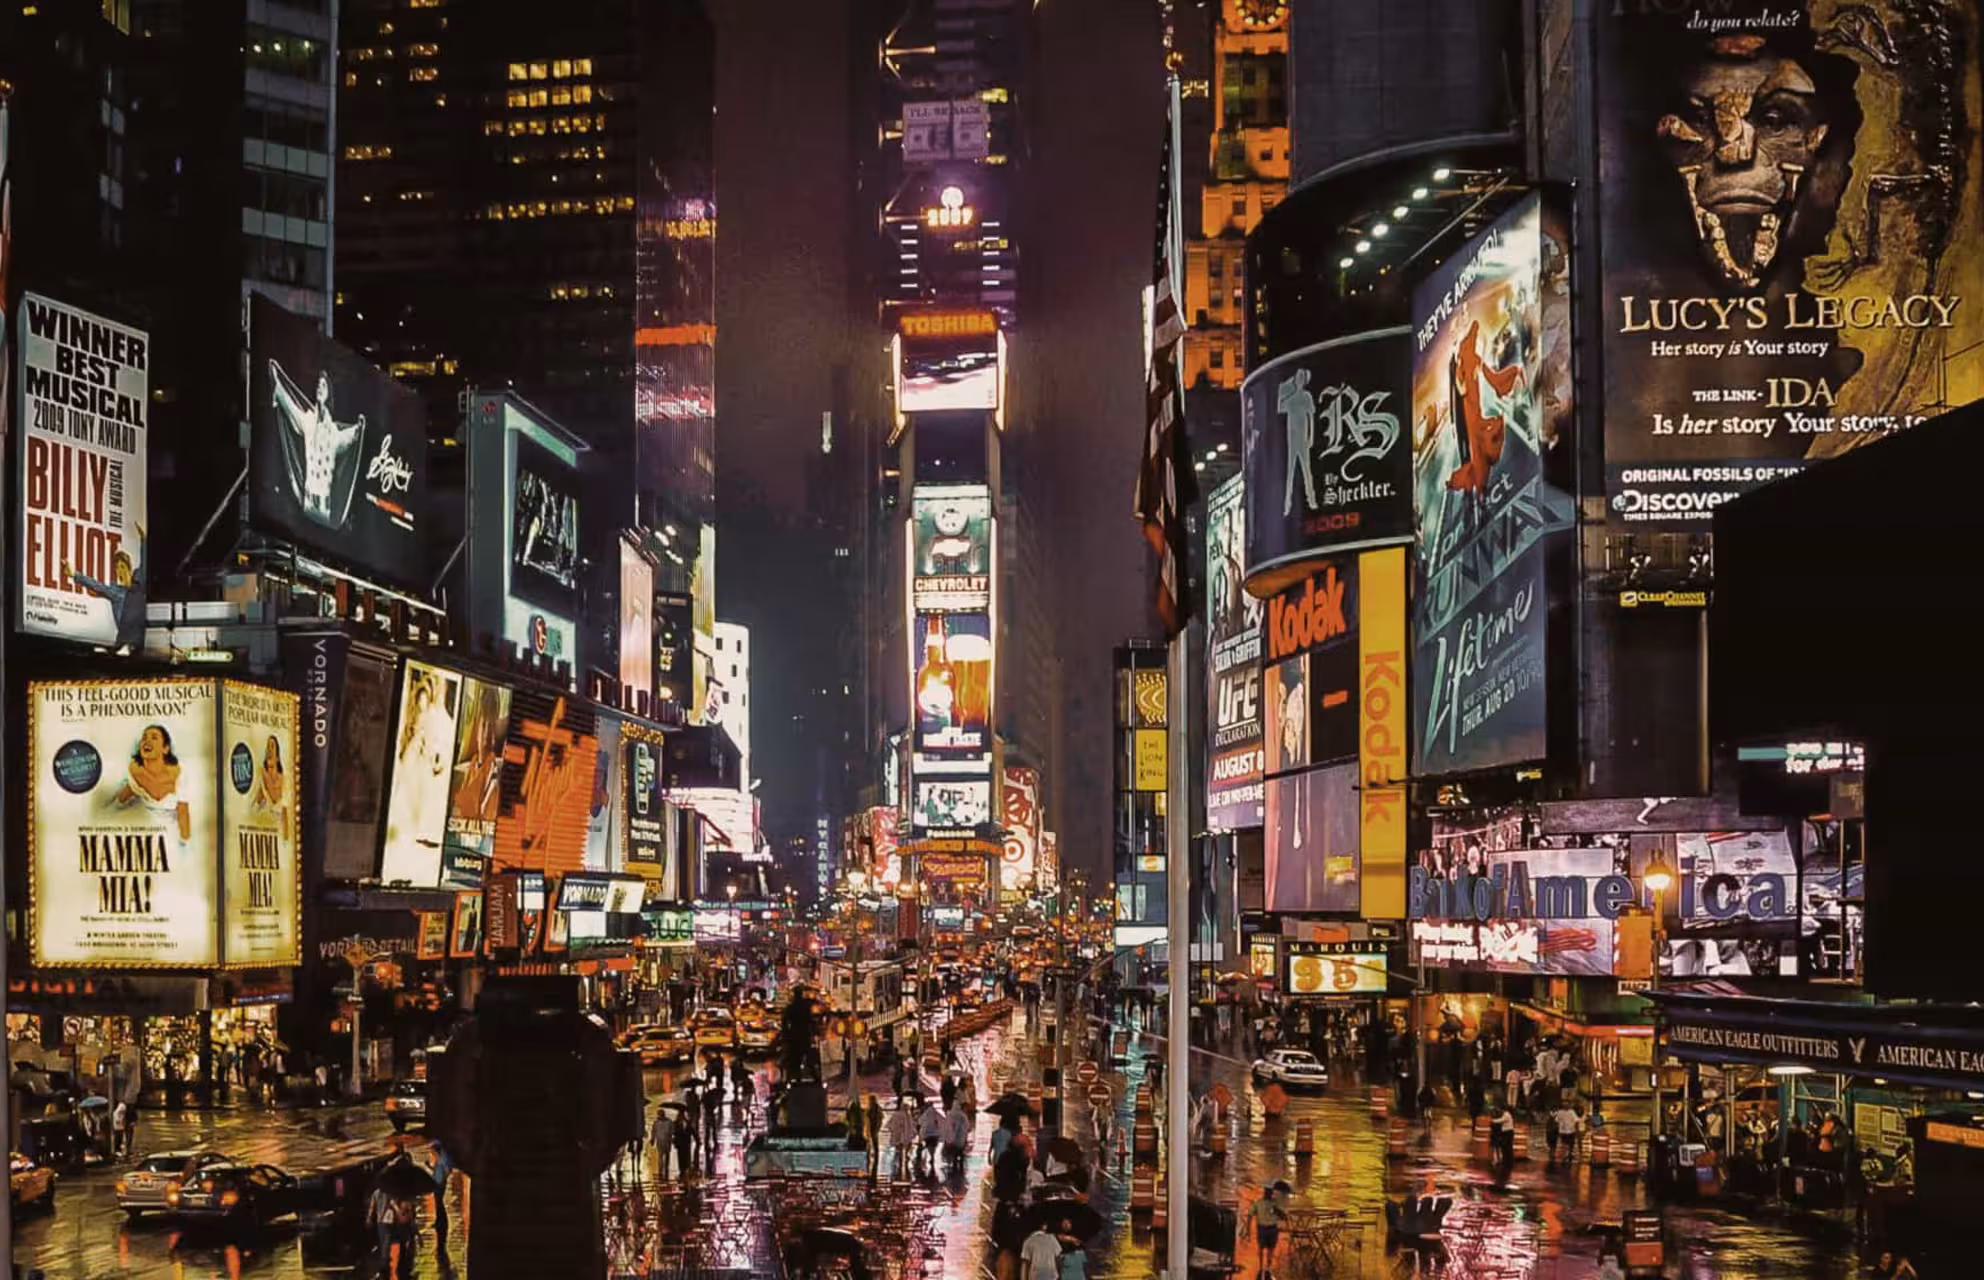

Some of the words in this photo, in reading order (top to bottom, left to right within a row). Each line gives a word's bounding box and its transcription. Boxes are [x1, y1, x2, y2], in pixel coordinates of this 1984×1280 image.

[1686, 10, 1708, 30] do
[1710, 16, 1741, 33] you
[1744, 8, 1801, 28] relate?
[1417, 292, 1454, 352] THEY'VE
[1454, 228, 1499, 305] ARRIVED!
[902, 314, 997, 336] TOSHIBA
[1619, 296, 1769, 334] LUCY'S
[1783, 293, 1961, 330] LEGACY
[27, 298, 147, 371] WINNER
[1651, 341, 1682, 357] Her
[1685, 343, 1725, 360] story
[1728, 341, 1742, 355] is
[1744, 340, 1784, 356] Your
[1787, 341, 1829, 359] story
[55, 346, 120, 391] BEST
[26, 365, 146, 428] MUSICAL
[1693, 390, 1721, 402] THE
[1766, 377, 1838, 408] IDA
[33, 399, 64, 436] 2009
[68, 408, 95, 446] TONY
[99, 416, 137, 455] AWARD
[1652, 414, 1674, 434] Is
[1679, 412, 1717, 434] her
[1722, 415, 1777, 438] story
[1784, 412, 1835, 434] Your
[27, 434, 109, 525] BILLY
[109, 460, 124, 499] MUSICAL
[1621, 468, 1692, 484] ORIGINAL
[1693, 467, 1753, 482] FOSSILS
[1755, 466, 1775, 481] OF
[108, 501, 123, 529] THE
[1649, 511, 1683, 520] SQUARE
[26, 513, 123, 598] ELLIOT
[915, 577, 987, 591] CHEVROLET
[1269, 565, 1347, 661] Kodak
[1423, 577, 1538, 758] Lifetime
[45, 688, 74, 702] THIS
[77, 686, 151, 702] FEEL-GOOD
[154, 684, 213, 700] MUSICAL
[61, 703, 74, 718] IS
[76, 703, 88, 717] A
[313, 639, 327, 748] VORNADO
[1218, 670, 1259, 727] UFC
[1364, 650, 1401, 824] Kodak
[1213, 751, 1255, 782] AUGUST
[79, 834, 170, 873] MAMMA
[238, 831, 279, 871] MAMMA
[98, 874, 152, 914] MIA!
[247, 871, 273, 908] MIA!
[560, 884, 608, 905] VORNADO
[1289, 943, 1388, 953] MARQUIS
[1670, 1024, 1724, 1047] AMERICAN
[1725, 1029, 1762, 1051] EAGLE
[1762, 1033, 1840, 1060] OUTFITTERS
[1877, 1044, 1956, 1071] AMERICAN
